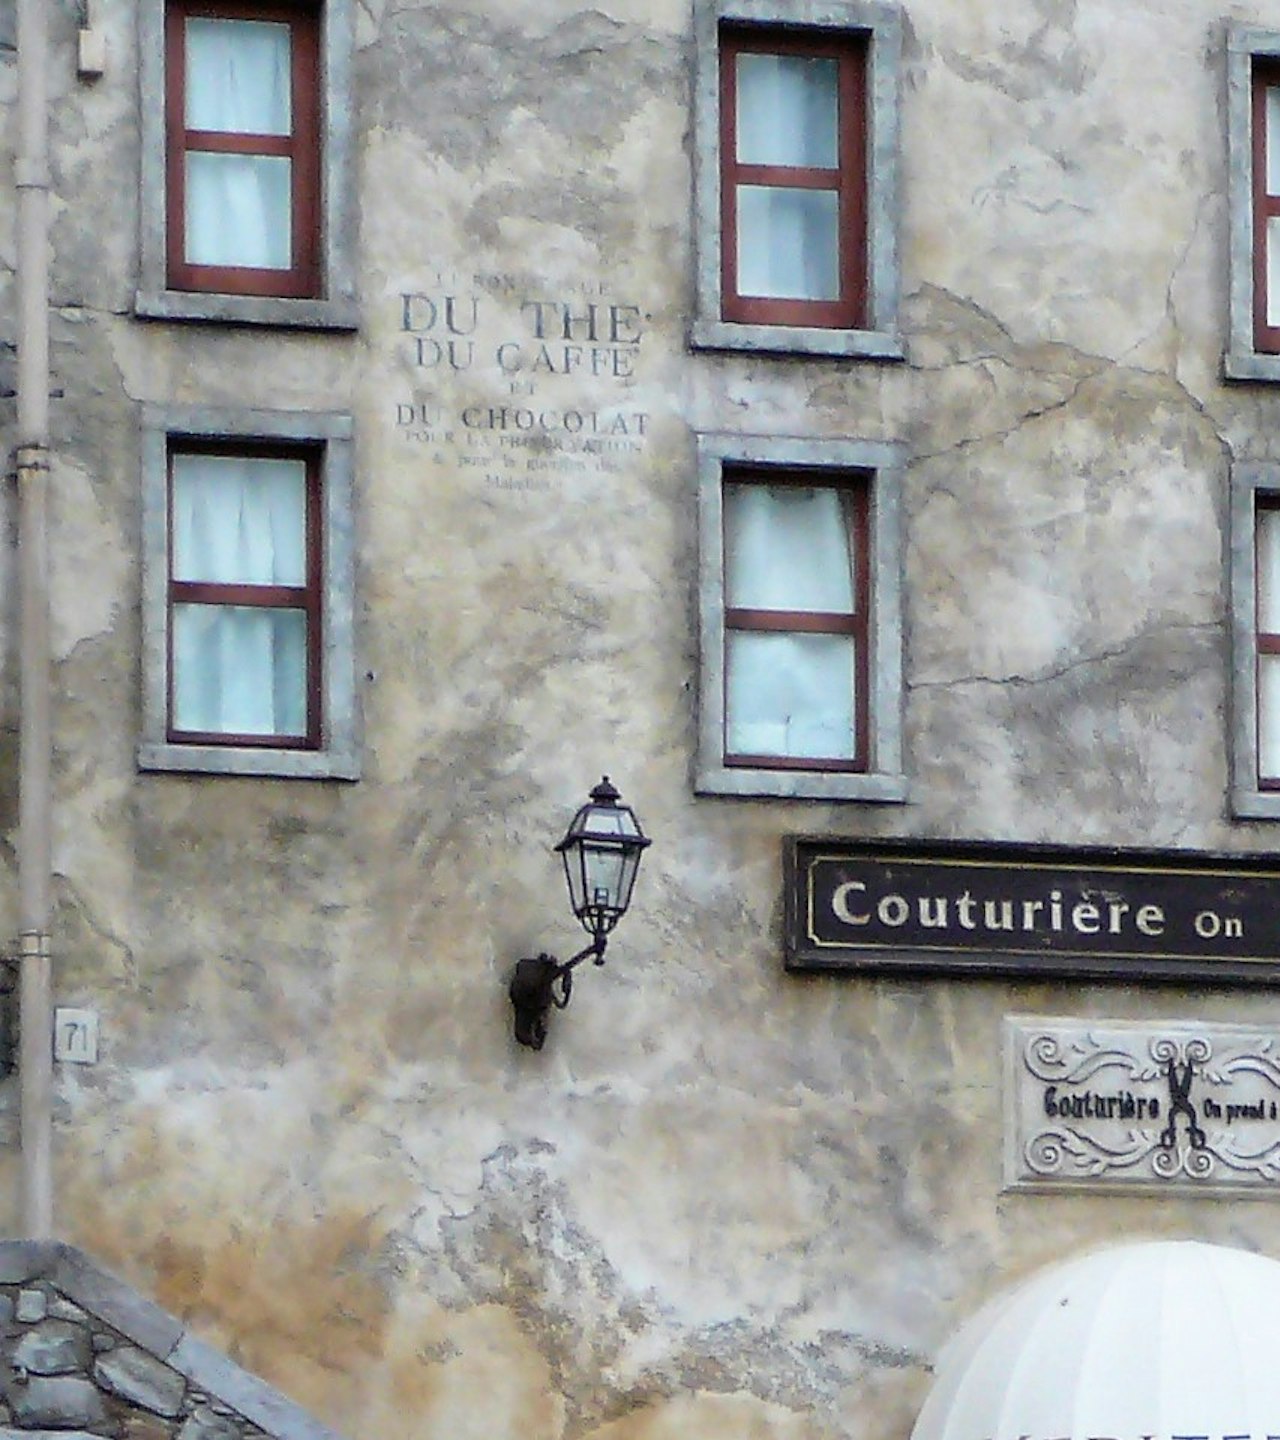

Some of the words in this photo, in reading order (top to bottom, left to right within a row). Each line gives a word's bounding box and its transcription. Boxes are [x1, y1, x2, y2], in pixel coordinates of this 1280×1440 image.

[400, 293, 479, 335] DU
[416, 338, 475, 370] DU
[461, 405, 651, 435] CHOCOLAT
[831, 880, 1166, 937] Couturière
[1194, 909, 1244, 938] On
